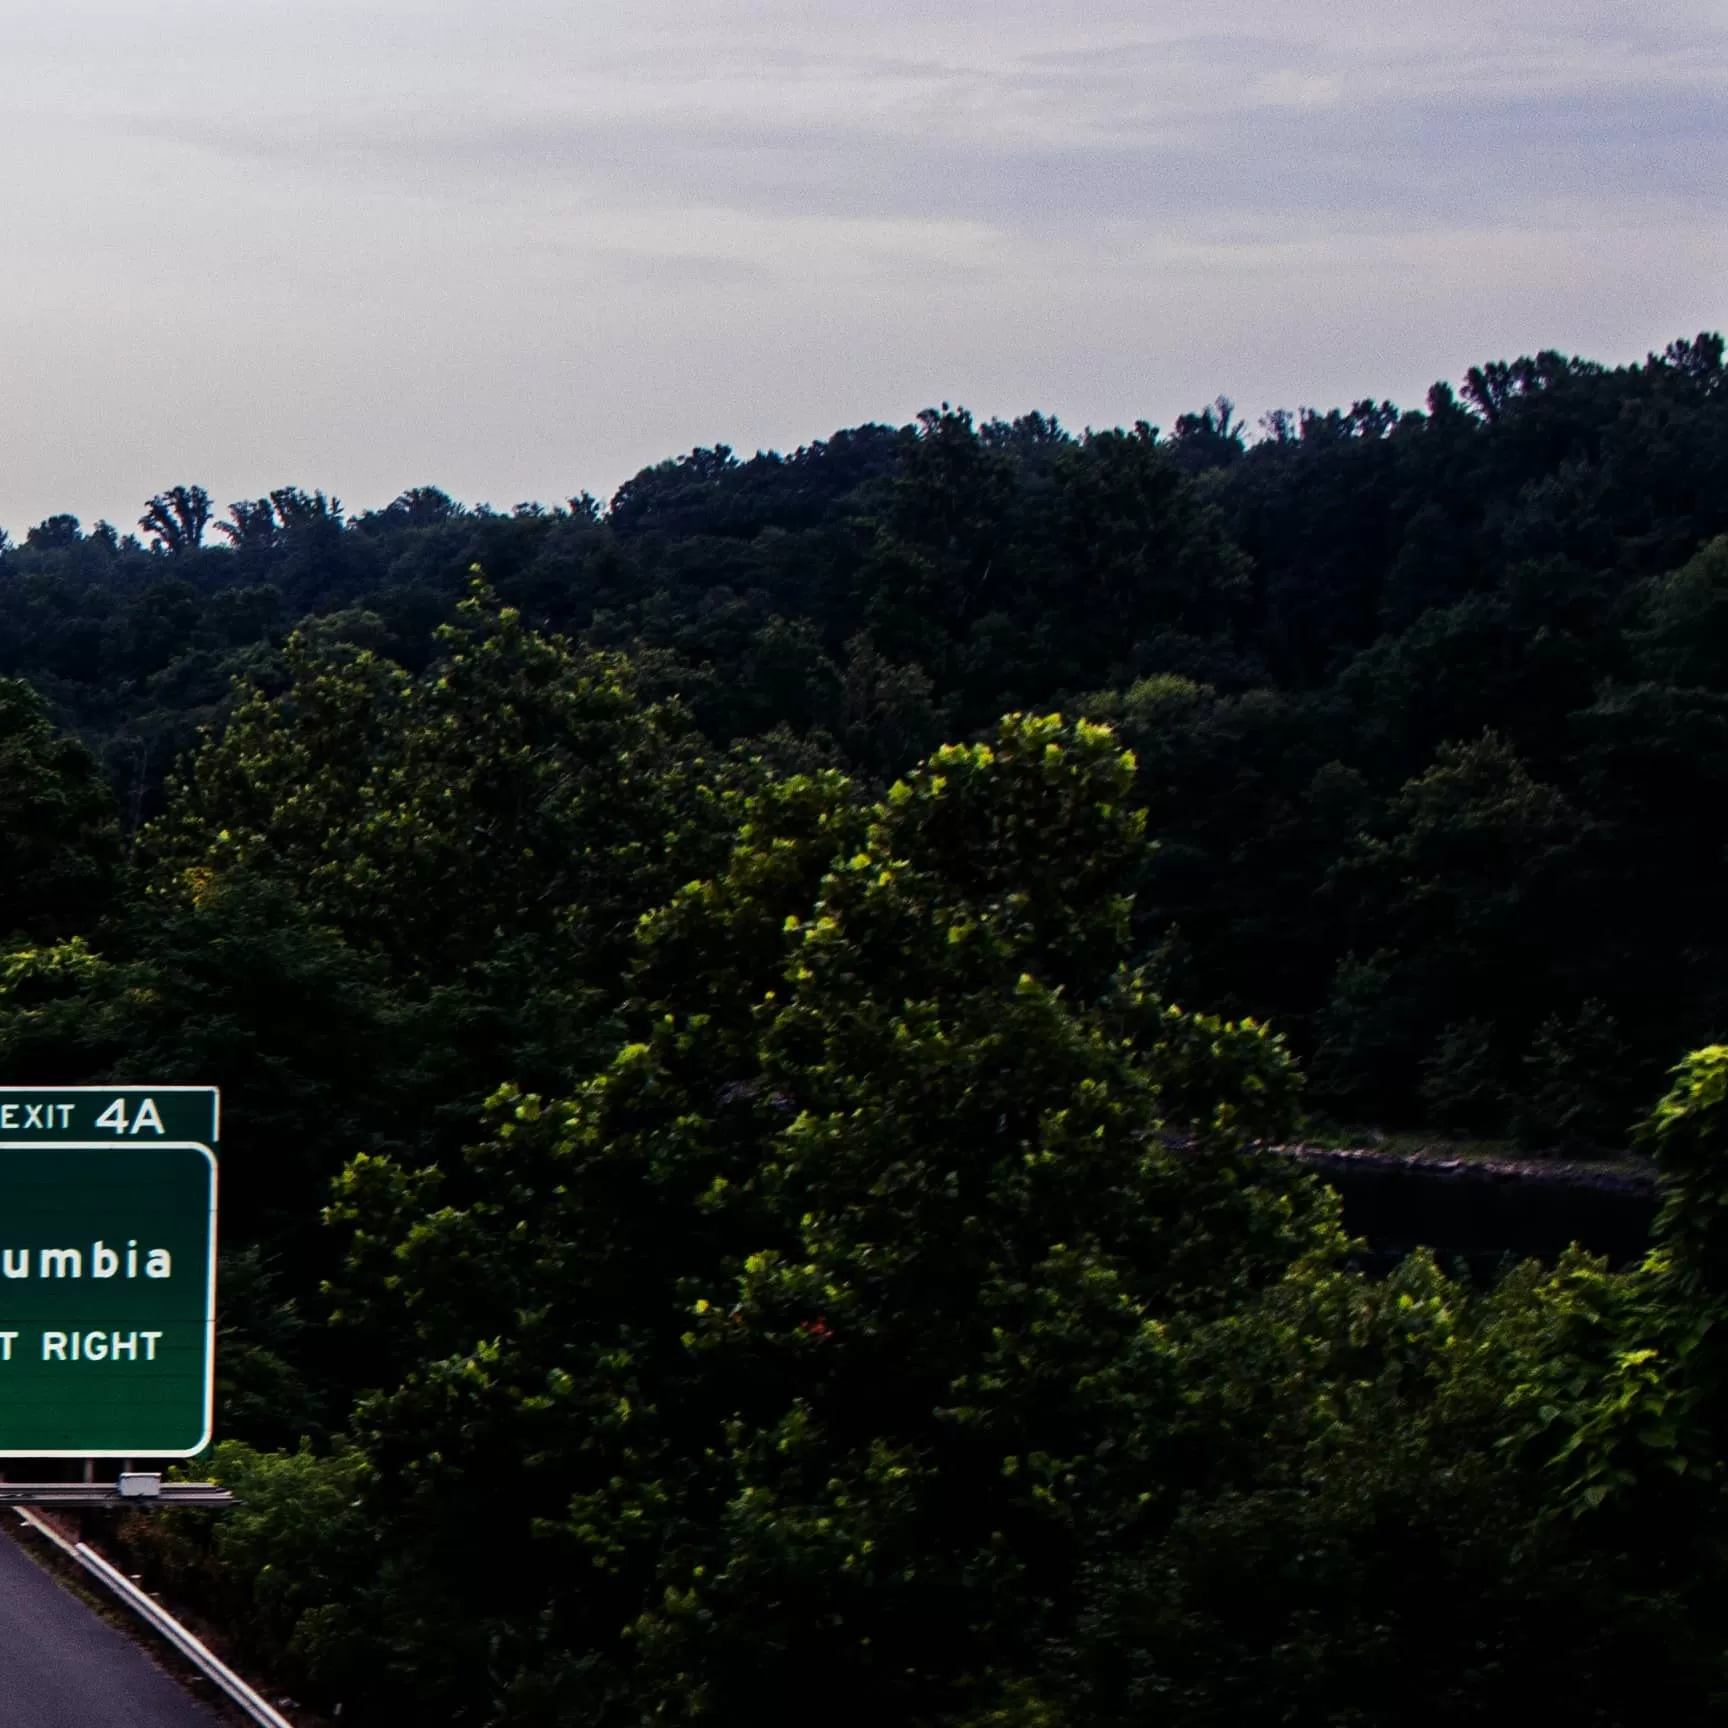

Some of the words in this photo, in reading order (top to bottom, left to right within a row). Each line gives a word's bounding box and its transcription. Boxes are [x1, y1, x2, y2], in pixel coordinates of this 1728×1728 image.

[1, 1103, 75, 1129] EXIT
[94, 1097, 166, 1135] 4A
[43, 1330, 163, 1361] RIGHT
